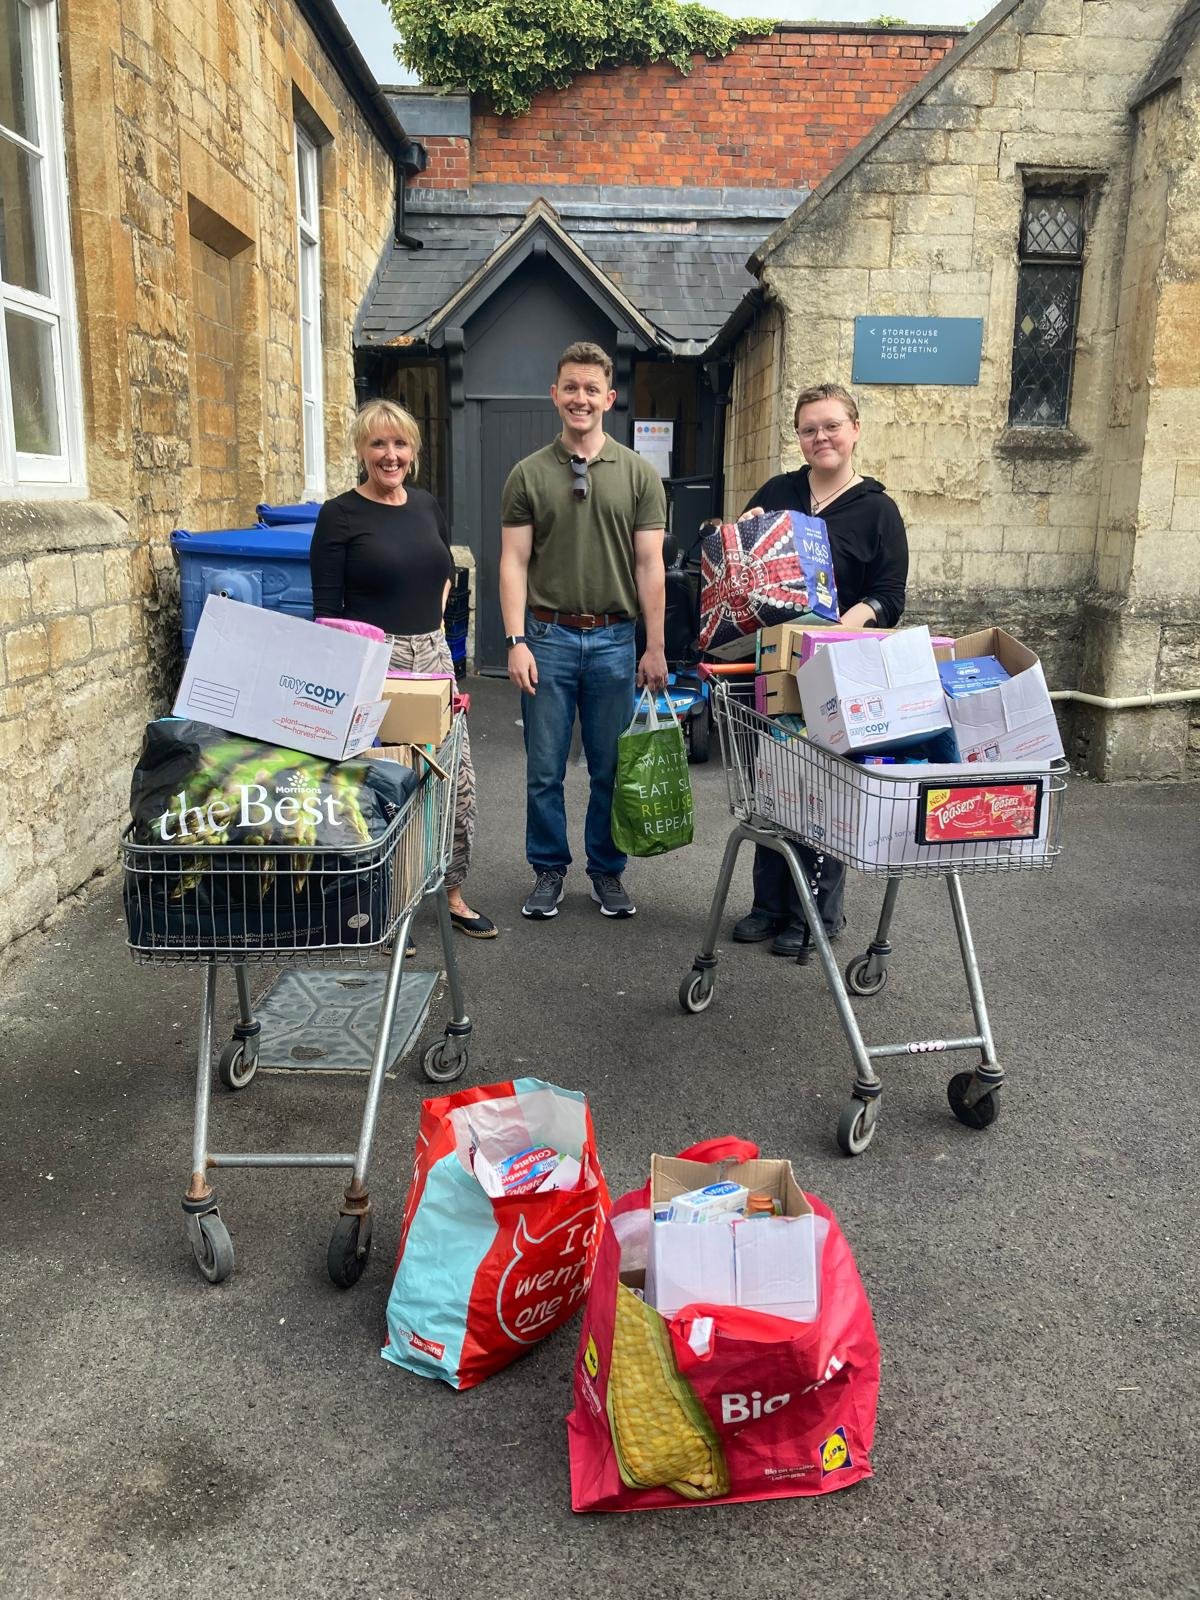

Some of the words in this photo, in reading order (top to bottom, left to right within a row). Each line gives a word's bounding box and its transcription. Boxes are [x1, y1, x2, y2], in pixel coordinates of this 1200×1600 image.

[882, 329, 938, 337] STOREHOUSE
[803, 539, 829, 559] M&S
[279, 674, 346, 706] mycopy
[293, 699, 334, 715] professional
[275, 786, 322, 794] Morrisons
[638, 781, 673, 799] EAT.
[930, 791, 948, 806] NEW
[156, 790, 231, 841] the
[232, 784, 343, 828] Best
[641, 793, 692, 817] RE-USE
[935, 799, 976, 830] Teasers
[991, 796, 1019, 813] Teasers
[644, 812, 694, 835] REPEAT
[512, 1149, 552, 1171] Colgate
[500, 1168, 529, 1184] olgate
[515, 1256, 587, 1300] went
[514, 1296, 564, 1327] one
